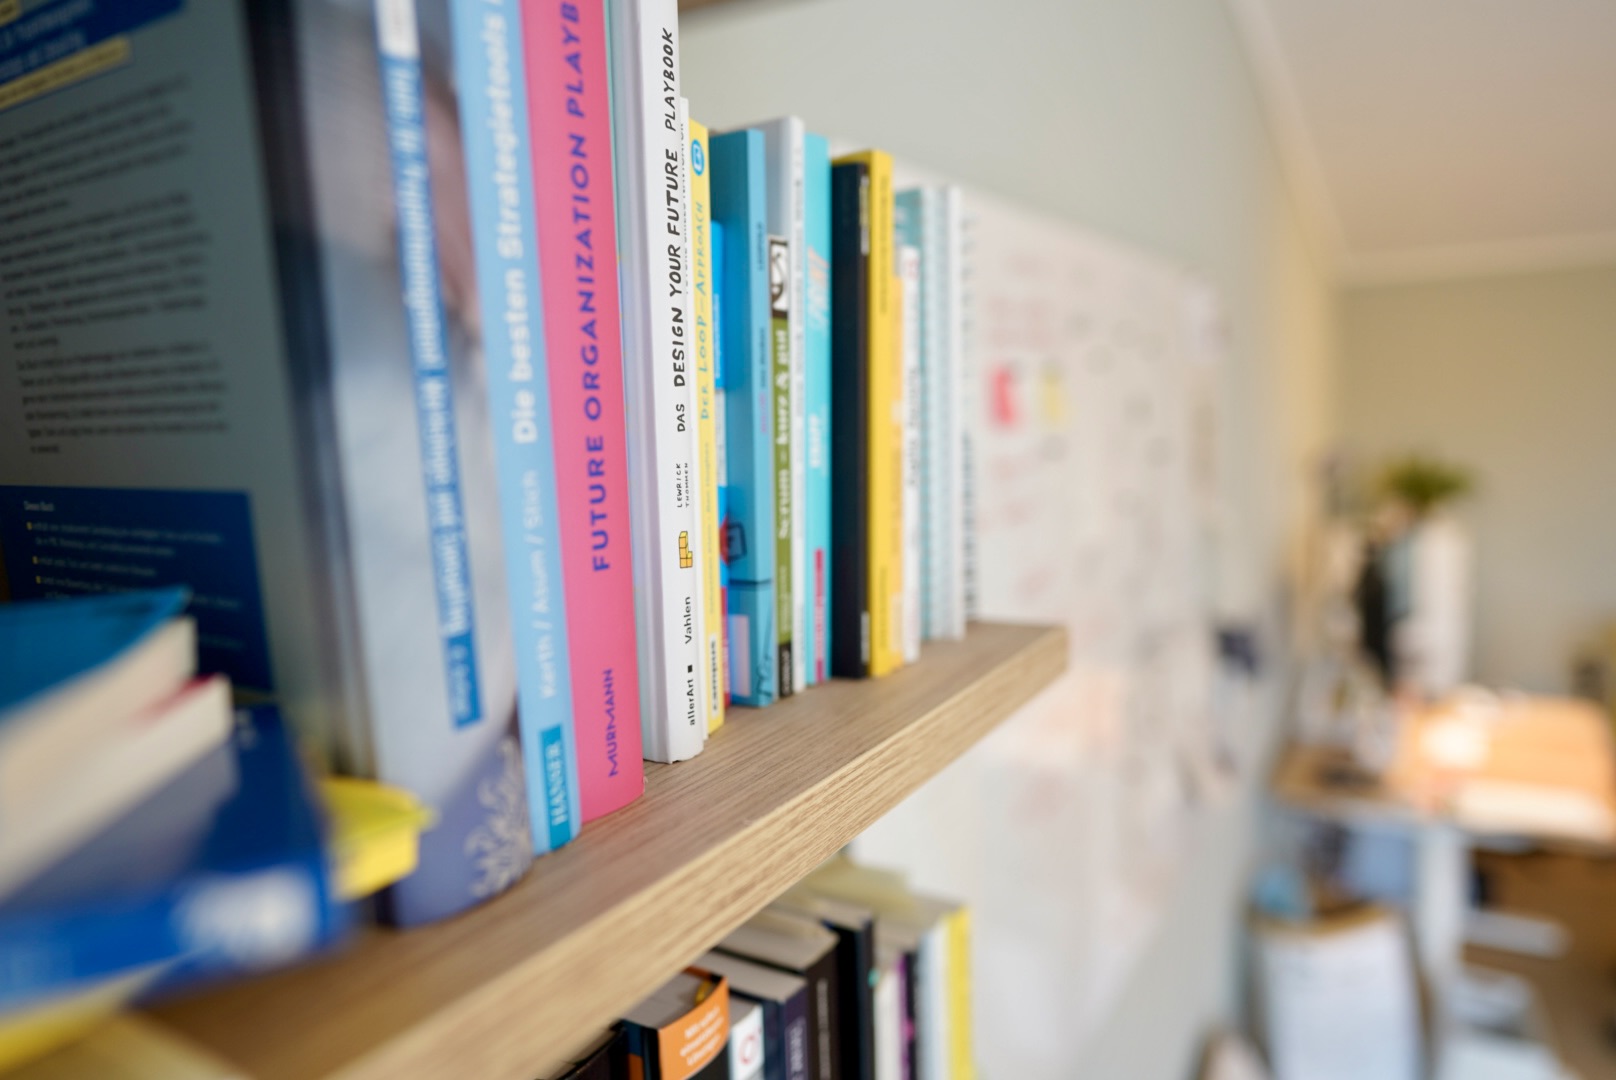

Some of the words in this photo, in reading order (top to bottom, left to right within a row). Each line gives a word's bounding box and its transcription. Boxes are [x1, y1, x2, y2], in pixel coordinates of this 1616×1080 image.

[662, 27, 678, 132] PLAYBOOK
[480, 13, 524, 260] Strategietools
[665, 148, 681, 236] FUTURE
[568, 133, 603, 421] ORGANIZATION
[667, 243, 682, 298] YOUR
[504, 267, 533, 381] besten
[671, 307, 686, 388] DESIGN
[512, 390, 538, 443] Die
[675, 403, 686, 432] DAS
[520, 470, 542, 529] Stich
[585, 435, 610, 572] FUTURE
[528, 550, 551, 613] Asum
[683, 595, 693, 645] Vahlen
[534, 636, 557, 699] Kerth
[686, 677, 696, 726] allerArt
[603, 668, 619, 777] MURMANN
[546, 741, 569, 827] HANSER
